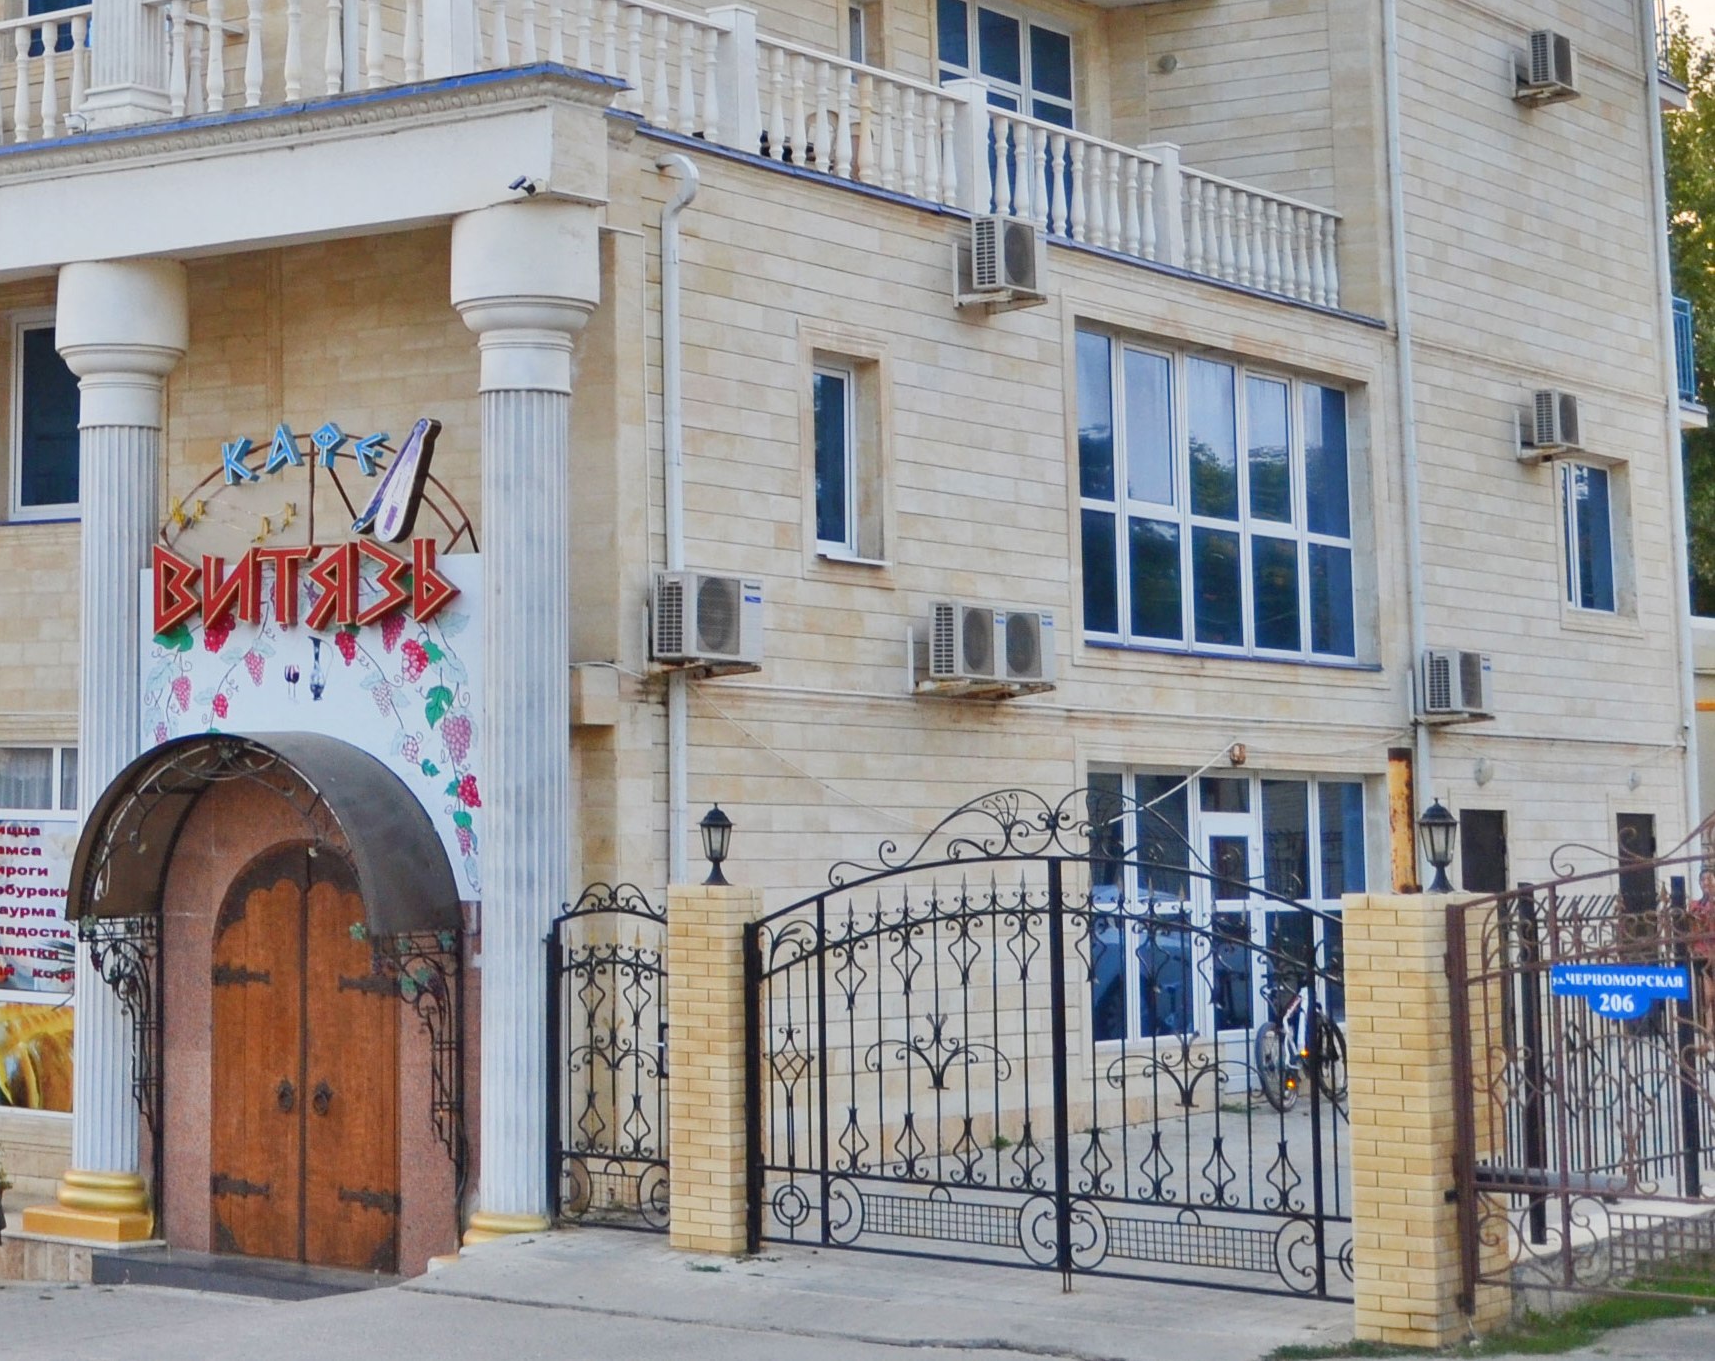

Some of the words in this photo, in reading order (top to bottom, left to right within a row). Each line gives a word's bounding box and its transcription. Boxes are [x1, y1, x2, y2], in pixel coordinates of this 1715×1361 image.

[221, 422, 389, 485] КАФЕ
[153, 537, 461, 634] ВИТЯЗЬ
[32, 968, 75, 982] коф
[1599, 993, 1635, 1013] 206
